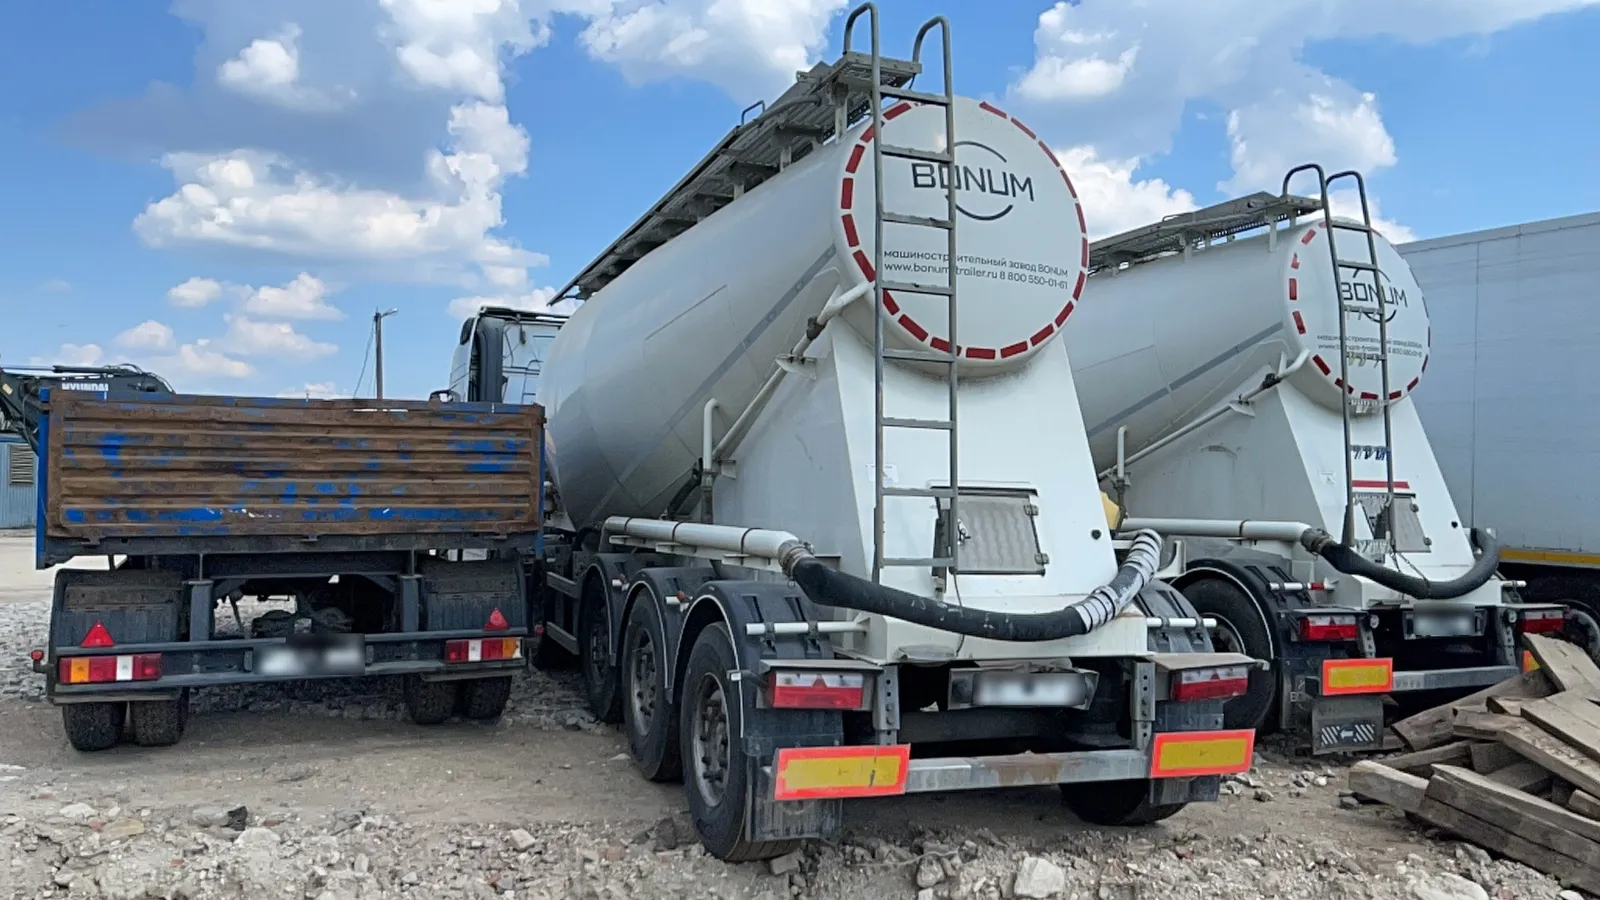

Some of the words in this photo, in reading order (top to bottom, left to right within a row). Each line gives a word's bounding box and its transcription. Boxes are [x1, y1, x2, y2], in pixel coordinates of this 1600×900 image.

[911, 163, 1034, 202] BONUM
[884, 250, 1007, 267] машинострительный
[1008, 260, 1037, 273] завод
[1037, 263, 1068, 277] BONUM
[884, 262, 998, 279] www.bonumtrailer.ru
[999, 270, 1006, 280] 8
[1007, 271, 1027, 283] 800
[1028, 274, 1068, 290] 550-01-61
[1340, 282, 1408, 308] BONUM
